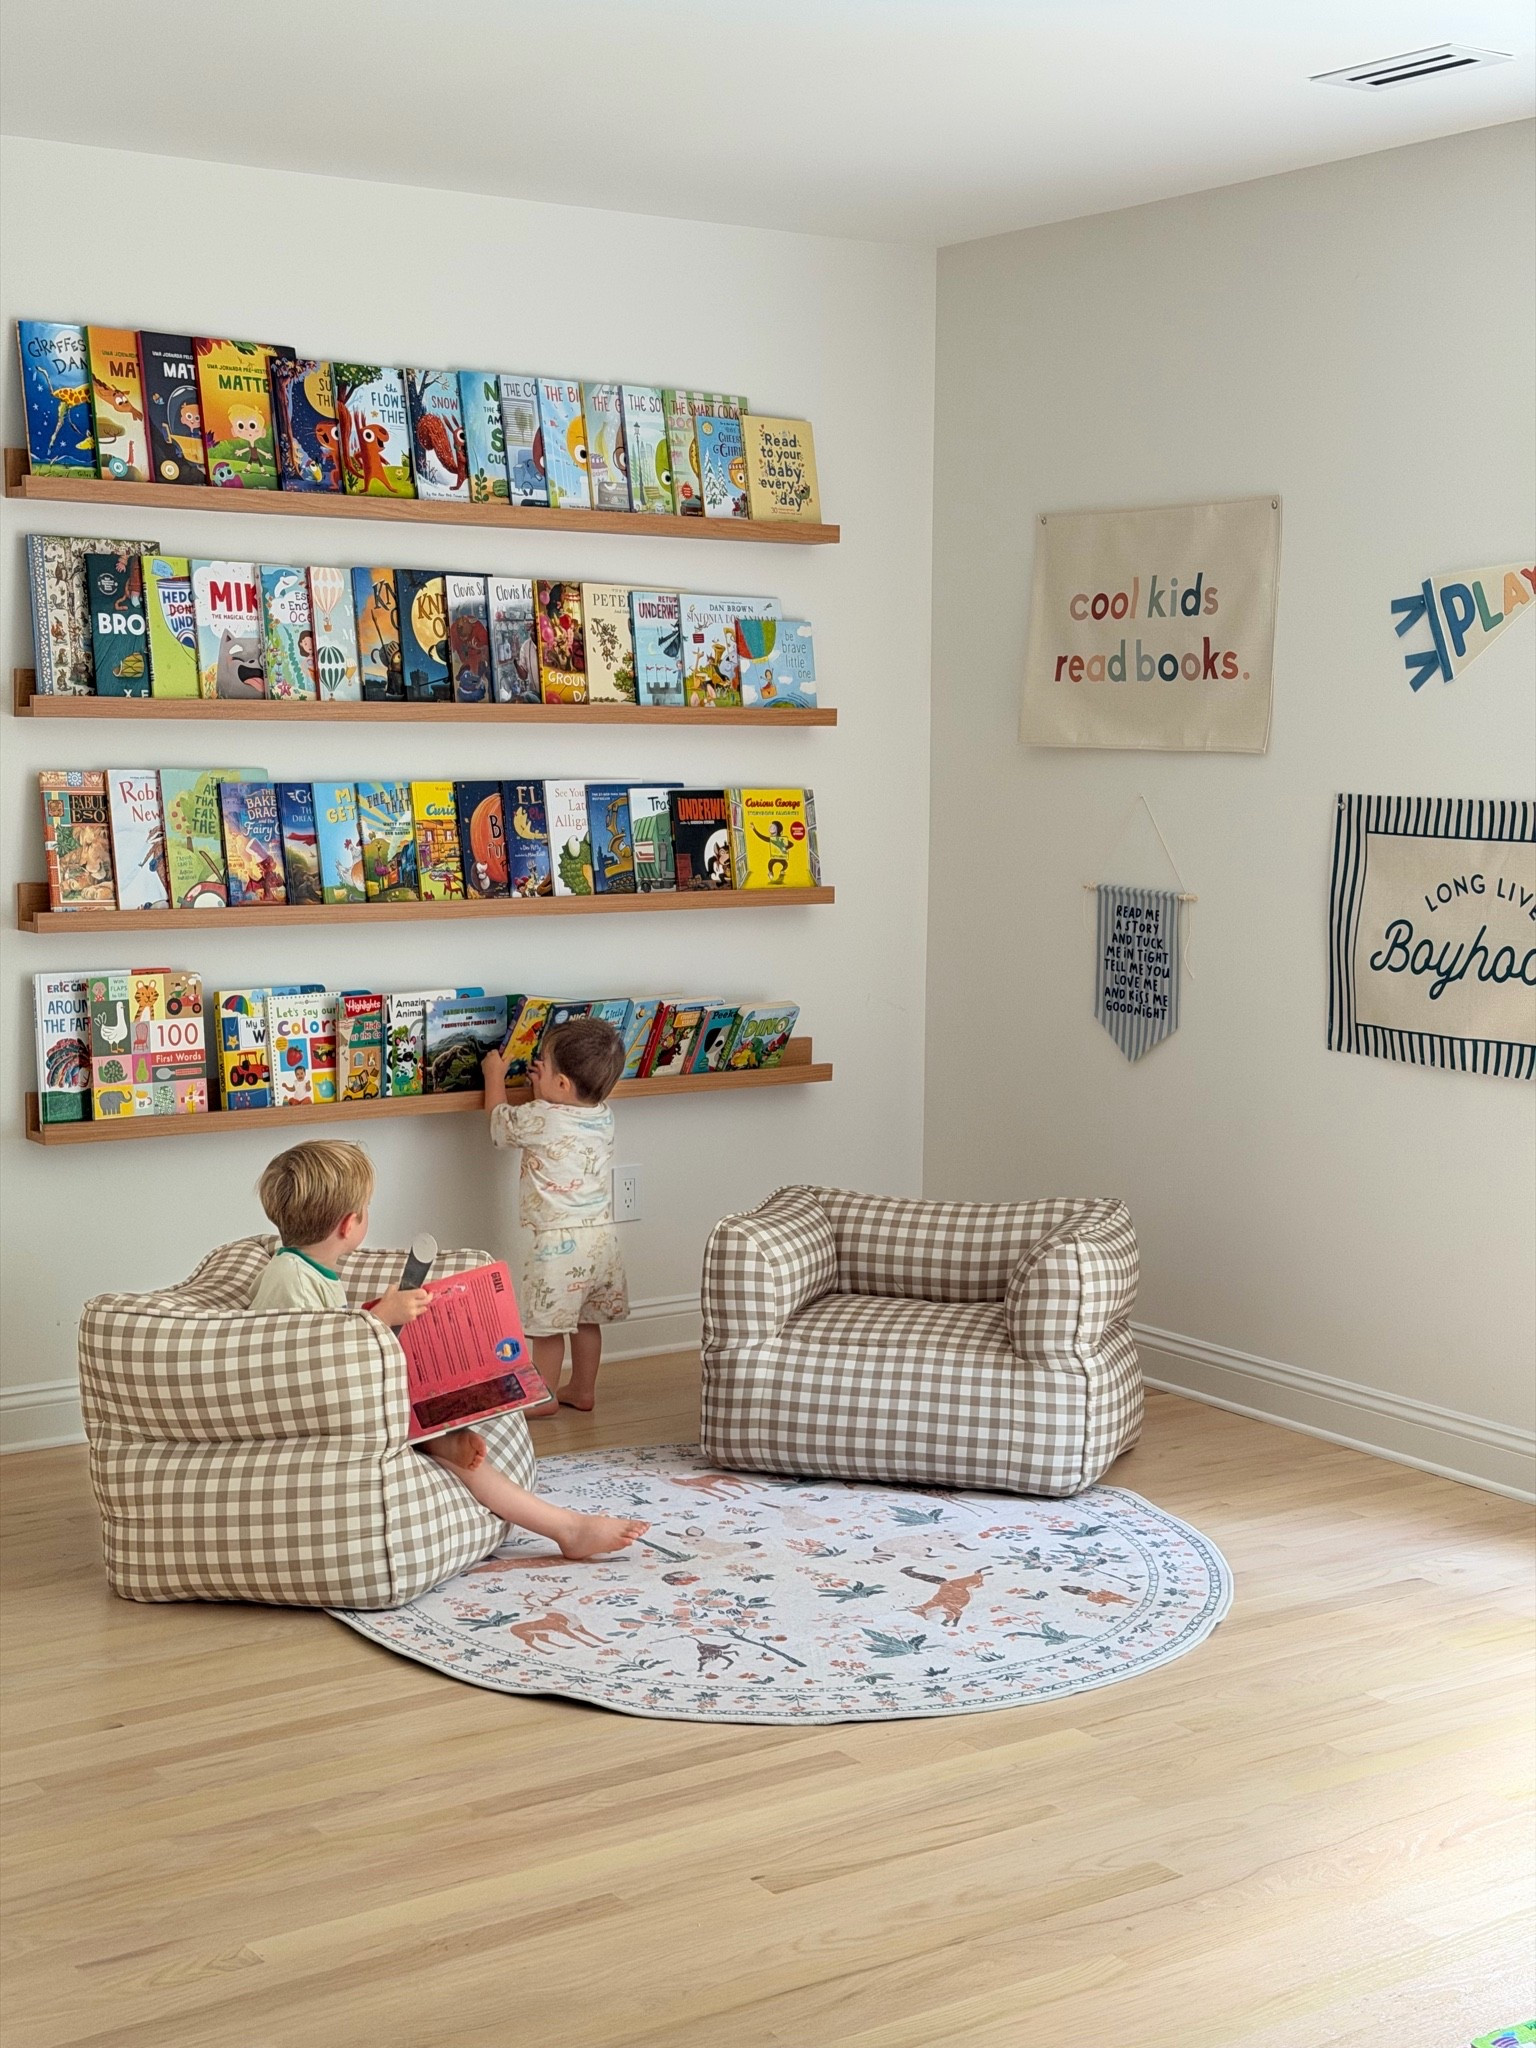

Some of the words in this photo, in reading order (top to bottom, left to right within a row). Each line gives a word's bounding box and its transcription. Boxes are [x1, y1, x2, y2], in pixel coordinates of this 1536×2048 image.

[28, 337, 86, 358] GIRAFFES
[218, 374, 270, 393] MATTE
[385, 384, 398, 392] the
[504, 383, 520, 397] THE
[371, 392, 406, 409] FLOWE
[544, 385, 564, 402] THE
[432, 396, 458, 410] SNOW
[592, 396, 610, 412] THE
[628, 394, 646, 412] THE
[671, 400, 686, 415] THE
[380, 410, 405, 424] THIE
[764, 433, 796, 448] Read
[761, 446, 774, 458] to
[776, 450, 801, 463] your
[768, 460, 802, 484] baby
[761, 480, 794, 494] every
[780, 491, 802, 512] day
[454, 582, 476, 598] Clovis
[496, 584, 520, 602] Clovis
[522, 584, 532, 600] Ke
[1070, 576, 1140, 621] cool
[1147, 572, 1219, 618] kids
[592, 593, 626, 608] PETE
[710, 604, 724, 612] DAN
[638, 602, 678, 620] UNDERWE
[98, 612, 146, 636] BRO
[784, 630, 794, 642] be
[782, 641, 806, 654] brave
[785, 656, 805, 668] little
[1054, 639, 1126, 682] read
[1136, 636, 1250, 682] books.
[798, 670, 812, 678] one
[366, 790, 386, 808] THE
[554, 788, 568, 798] See
[569, 788, 584, 798] You
[246, 796, 277, 810] BAKE
[745, 798, 774, 808] Curious
[775, 798, 800, 810] George
[195, 808, 216, 820] FAR
[248, 806, 278, 820] DRAG
[192, 818, 216, 834] THE
[554, 815, 588, 830] Alliga
[243, 821, 272, 842] Fairy
[1424, 874, 1486, 912] LONG
[1116, 904, 1142, 919] READ
[1145, 908, 1160, 922] ME
[1116, 920, 1122, 930] A
[1125, 920, 1159, 935] STORY
[1112, 932, 1132, 946] AND
[1136, 934, 1163, 950] TUCK
[1106, 946, 1120, 958] ME
[1104, 958, 1126, 972] TELL
[1129, 962, 1143, 976] ME
[1146, 964, 1170, 978] YOU
[1114, 974, 1140, 988] LOVE
[1144, 978, 1158, 992] ME
[1104, 986, 1126, 1000] AND
[1152, 993, 1168, 1008] ME
[276, 1007, 300, 1018] Let's
[302, 1008, 318, 1018] say
[322, 1006, 336, 1015] our
[346, 998, 381, 1013] Highlights
[44, 1018, 66, 1034] THE
[246, 1020, 258, 1030] My
[278, 1018, 336, 1036] colors
[743, 1016, 790, 1038] DINO
[158, 1022, 198, 1046] 100
[360, 1032, 372, 1040] the
[156, 1054, 174, 1063] First
[176, 1051, 202, 1062] Words
